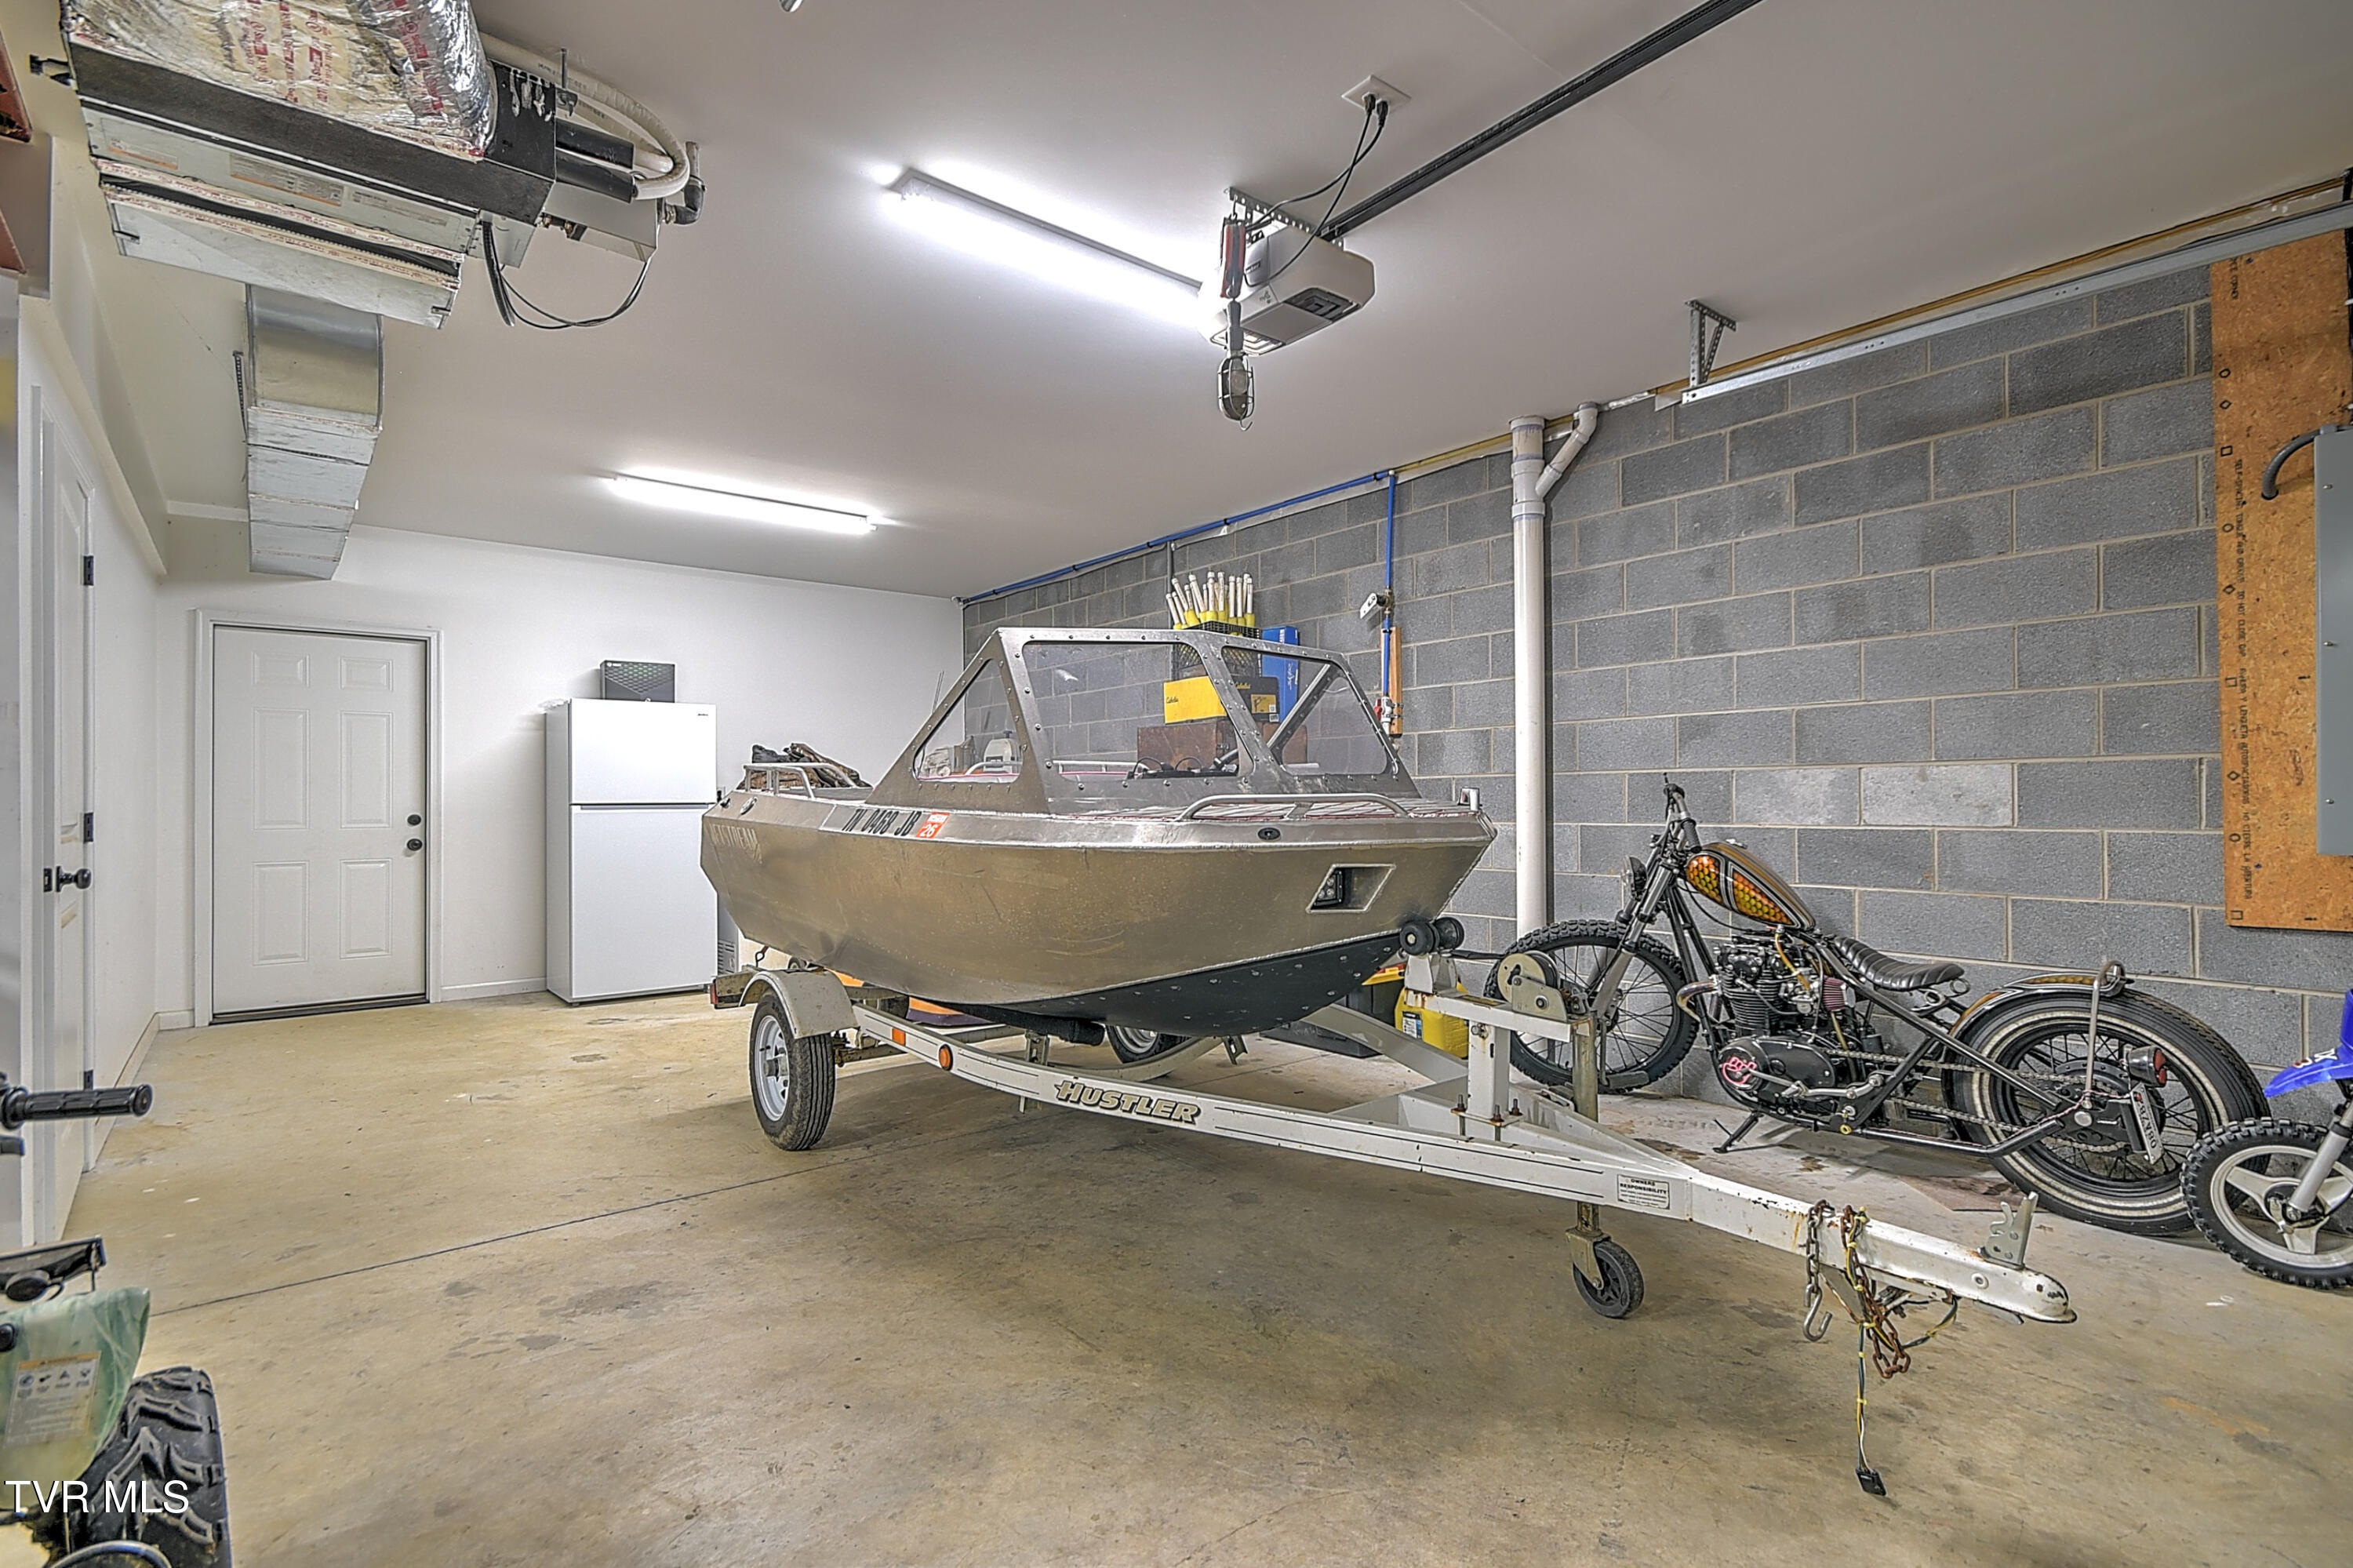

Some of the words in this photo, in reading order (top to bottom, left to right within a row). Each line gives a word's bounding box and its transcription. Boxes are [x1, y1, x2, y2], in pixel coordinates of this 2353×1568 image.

[2238, 591, 2245, 600] DO
[2244, 853, 2251, 862] LA
[842, 809, 867, 831] TN
[861, 809, 899, 834] 0468
[894, 810, 922, 836] JB
[920, 824, 938, 837] 26
[1055, 1080, 1201, 1124] HUSTLER
[1620, 1183, 1667, 1194] RESPONSIBILITY
